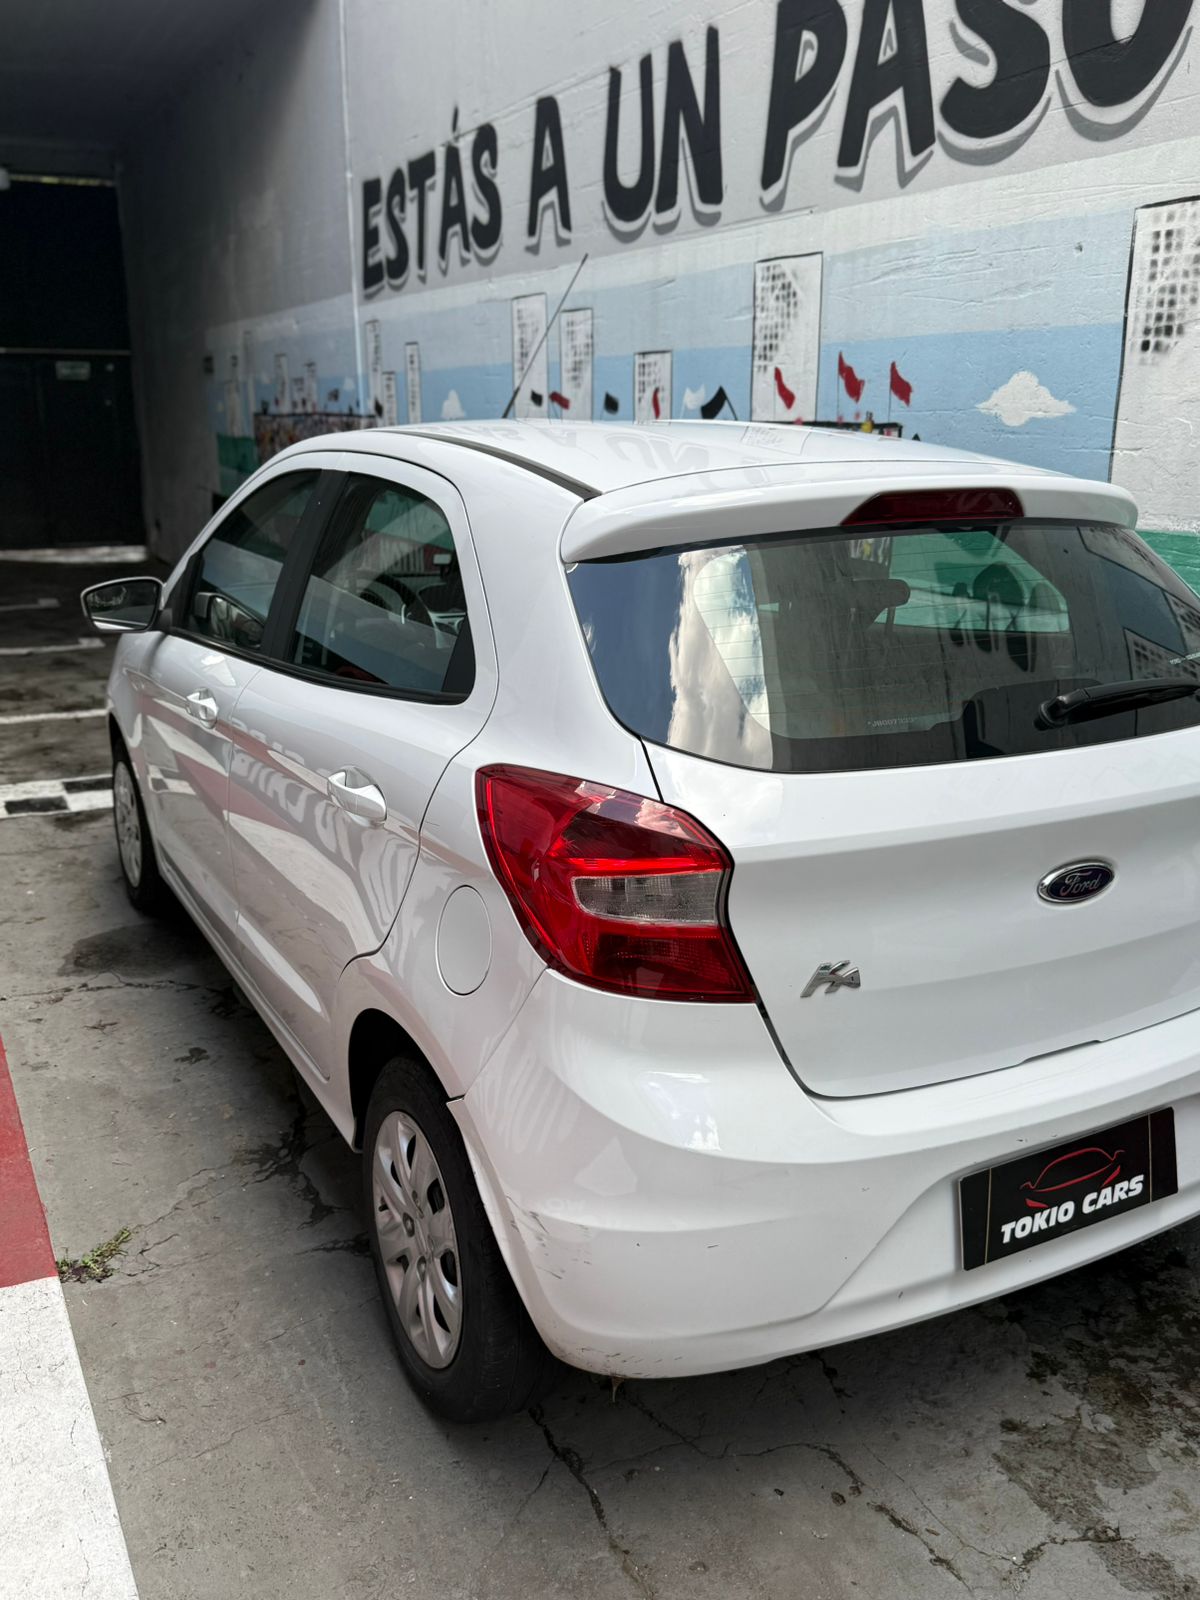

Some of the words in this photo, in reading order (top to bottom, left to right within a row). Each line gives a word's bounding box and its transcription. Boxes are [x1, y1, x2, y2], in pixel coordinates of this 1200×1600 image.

[363, 106, 502, 294] ESTÁS
[527, 95, 572, 242] A
[603, 24, 724, 230] UN
[1059, 870, 1103, 897] Ford
[1001, 1200, 1076, 1244] TOKIO
[1082, 1174, 1145, 1215] CARS
